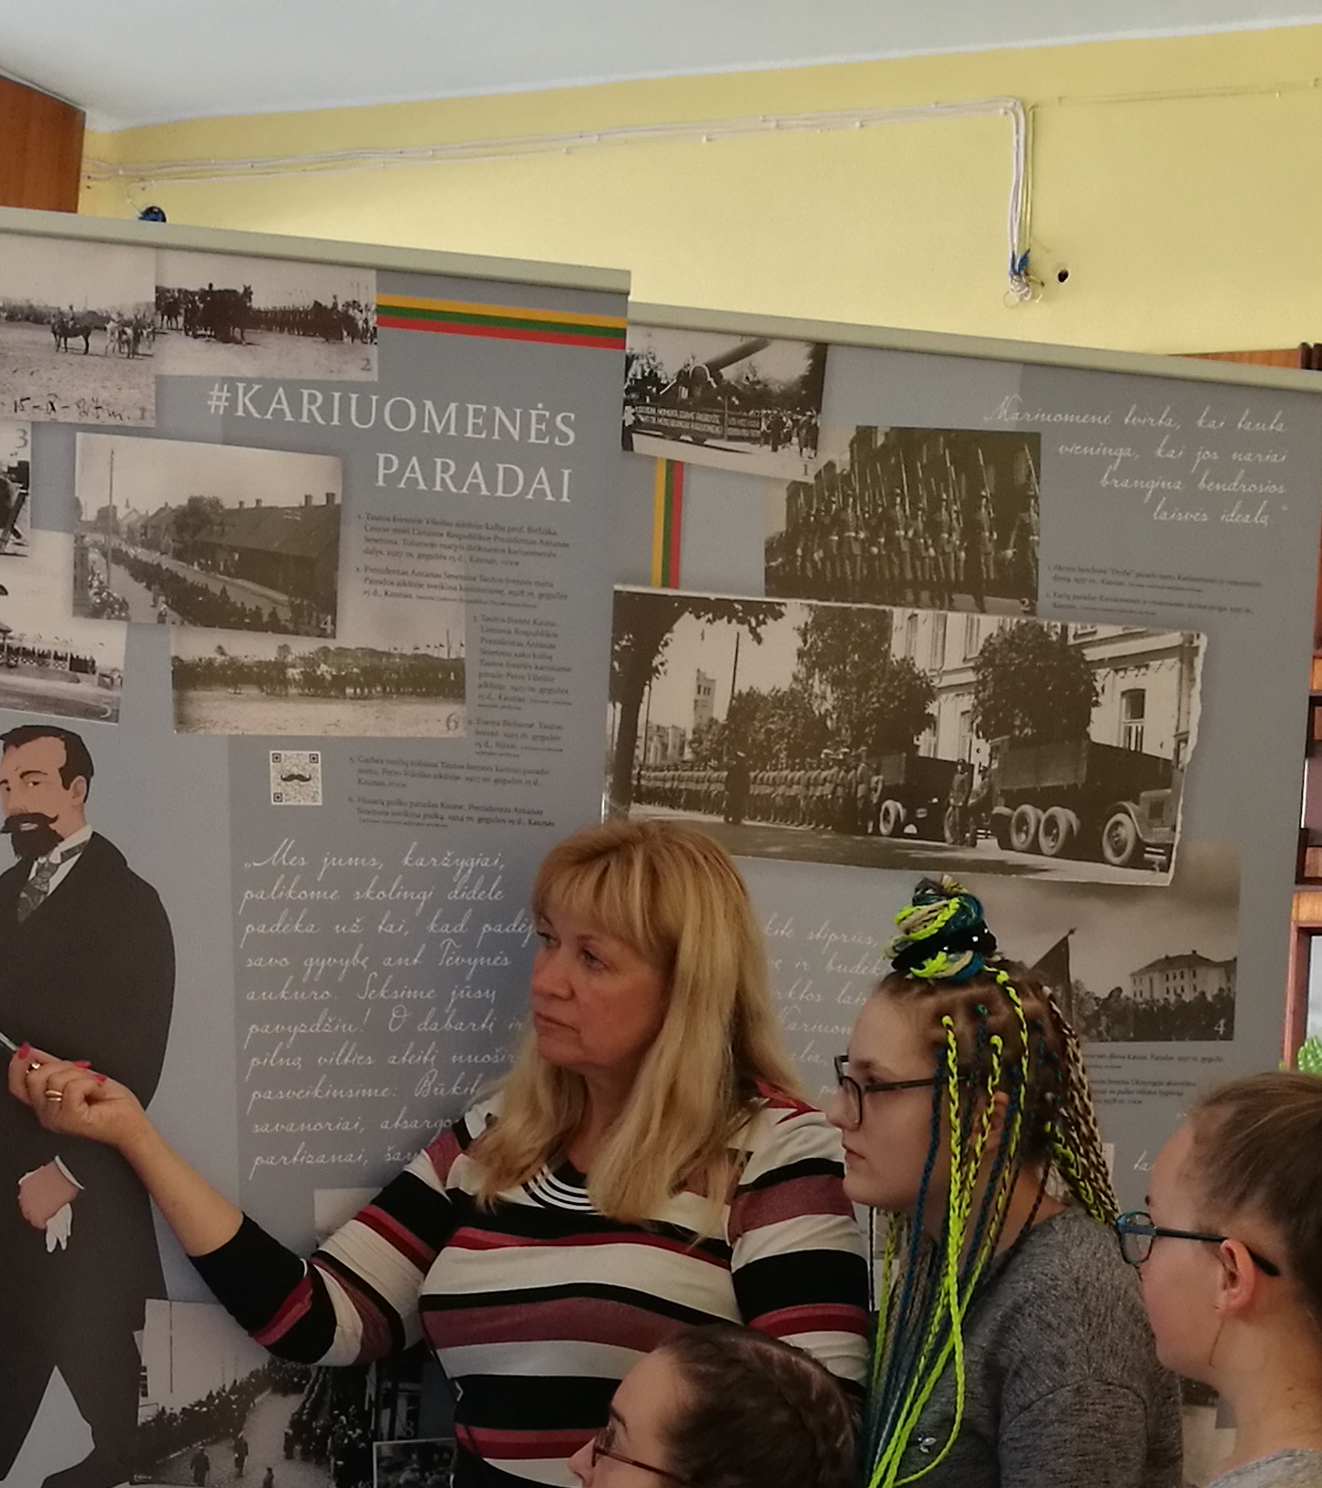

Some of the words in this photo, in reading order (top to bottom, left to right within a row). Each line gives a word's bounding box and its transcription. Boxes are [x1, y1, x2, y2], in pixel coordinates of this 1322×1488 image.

[360, 358, 372, 371] 2
[207, 382, 576, 446] #KARIUOMENĖS
[1196, 405, 1225, 430] kai
[1237, 408, 1289, 433] tauta
[15, 429, 28, 448] 3
[1155, 434, 1184, 459] kai
[1191, 446, 1220, 474] jos
[375, 452, 572, 502] PARADAI
[1100, 465, 1183, 504] brangina
[1020, 598, 1031, 612] 2
[320, 615, 333, 634] 4
[446, 712, 459, 731] 6
[317, 852, 384, 881] jums,
[402, 842, 505, 882] karžygiai,
[239, 875, 338, 915] palikome
[354, 875, 434, 916] skolingi
[334, 916, 364, 934] už
[377, 910, 409, 936] tai,
[428, 909, 472, 933] kad
[246, 956, 290, 967] savo
[382, 944, 426, 967] ant
[357, 972, 437, 1000] Seksime
[388, 1004, 412, 1032] O
[1214, 1020, 1225, 1035] 4
[245, 1042, 303, 1082] pilną
[253, 1117, 365, 1135] savanoriai,
